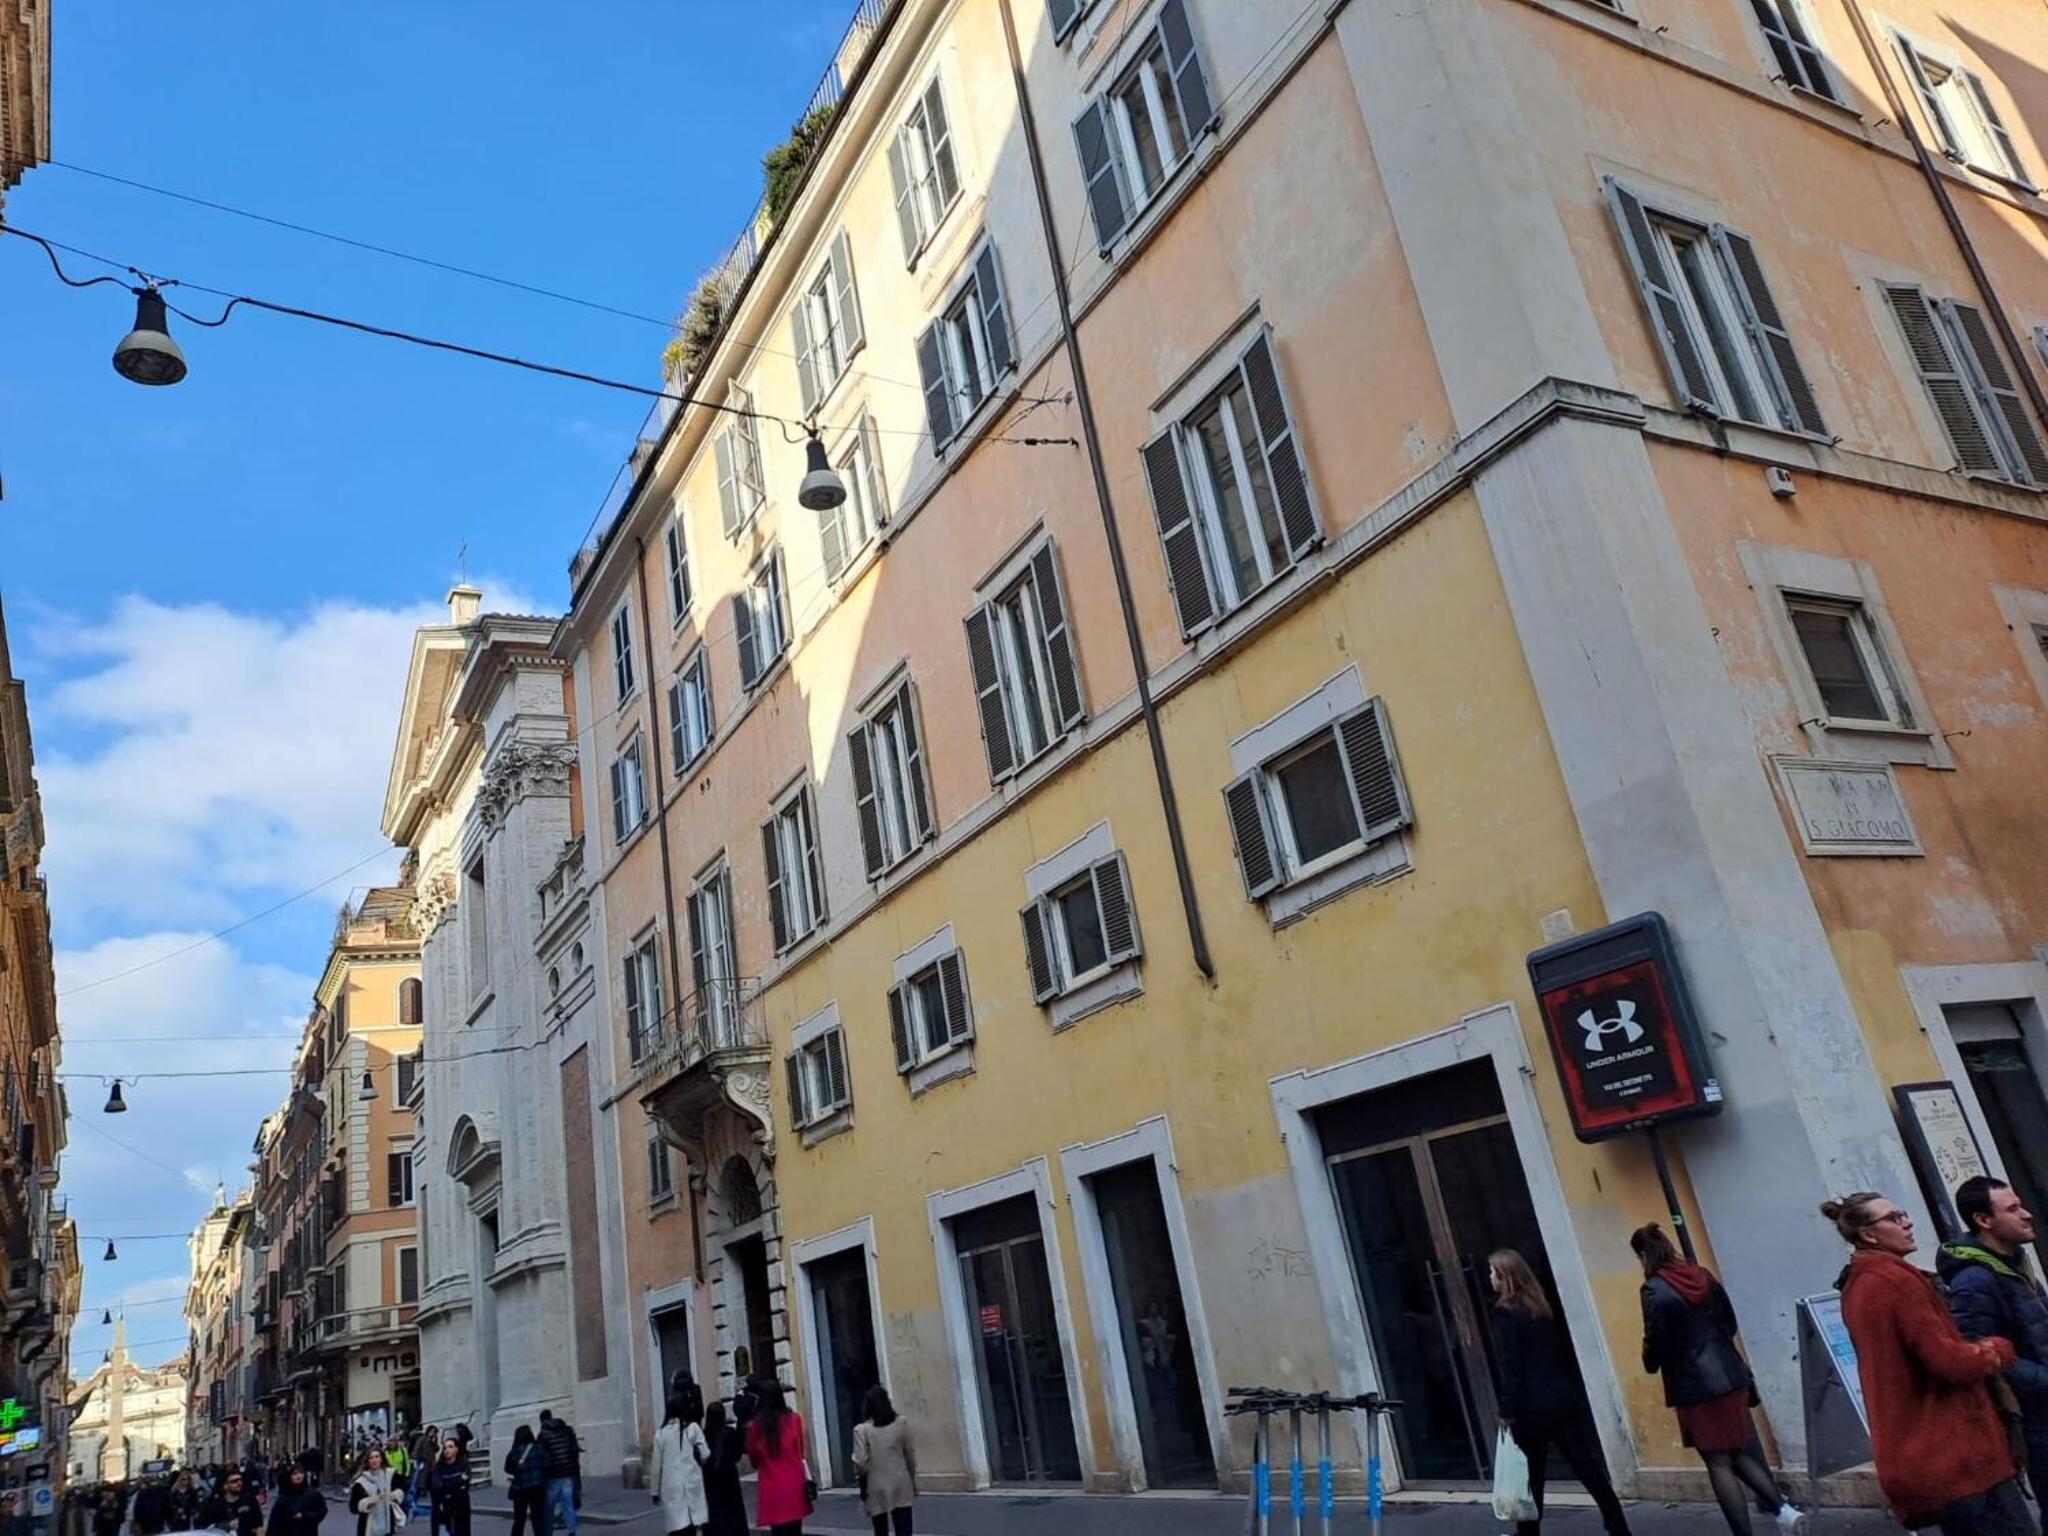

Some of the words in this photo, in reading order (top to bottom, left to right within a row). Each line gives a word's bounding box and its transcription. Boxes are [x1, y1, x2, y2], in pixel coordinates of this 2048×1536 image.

[1828, 819, 1905, 838] GIACOMO
[1585, 1055, 1616, 1069] UNDER
[1616, 1044, 1655, 1061] ARMOUR
